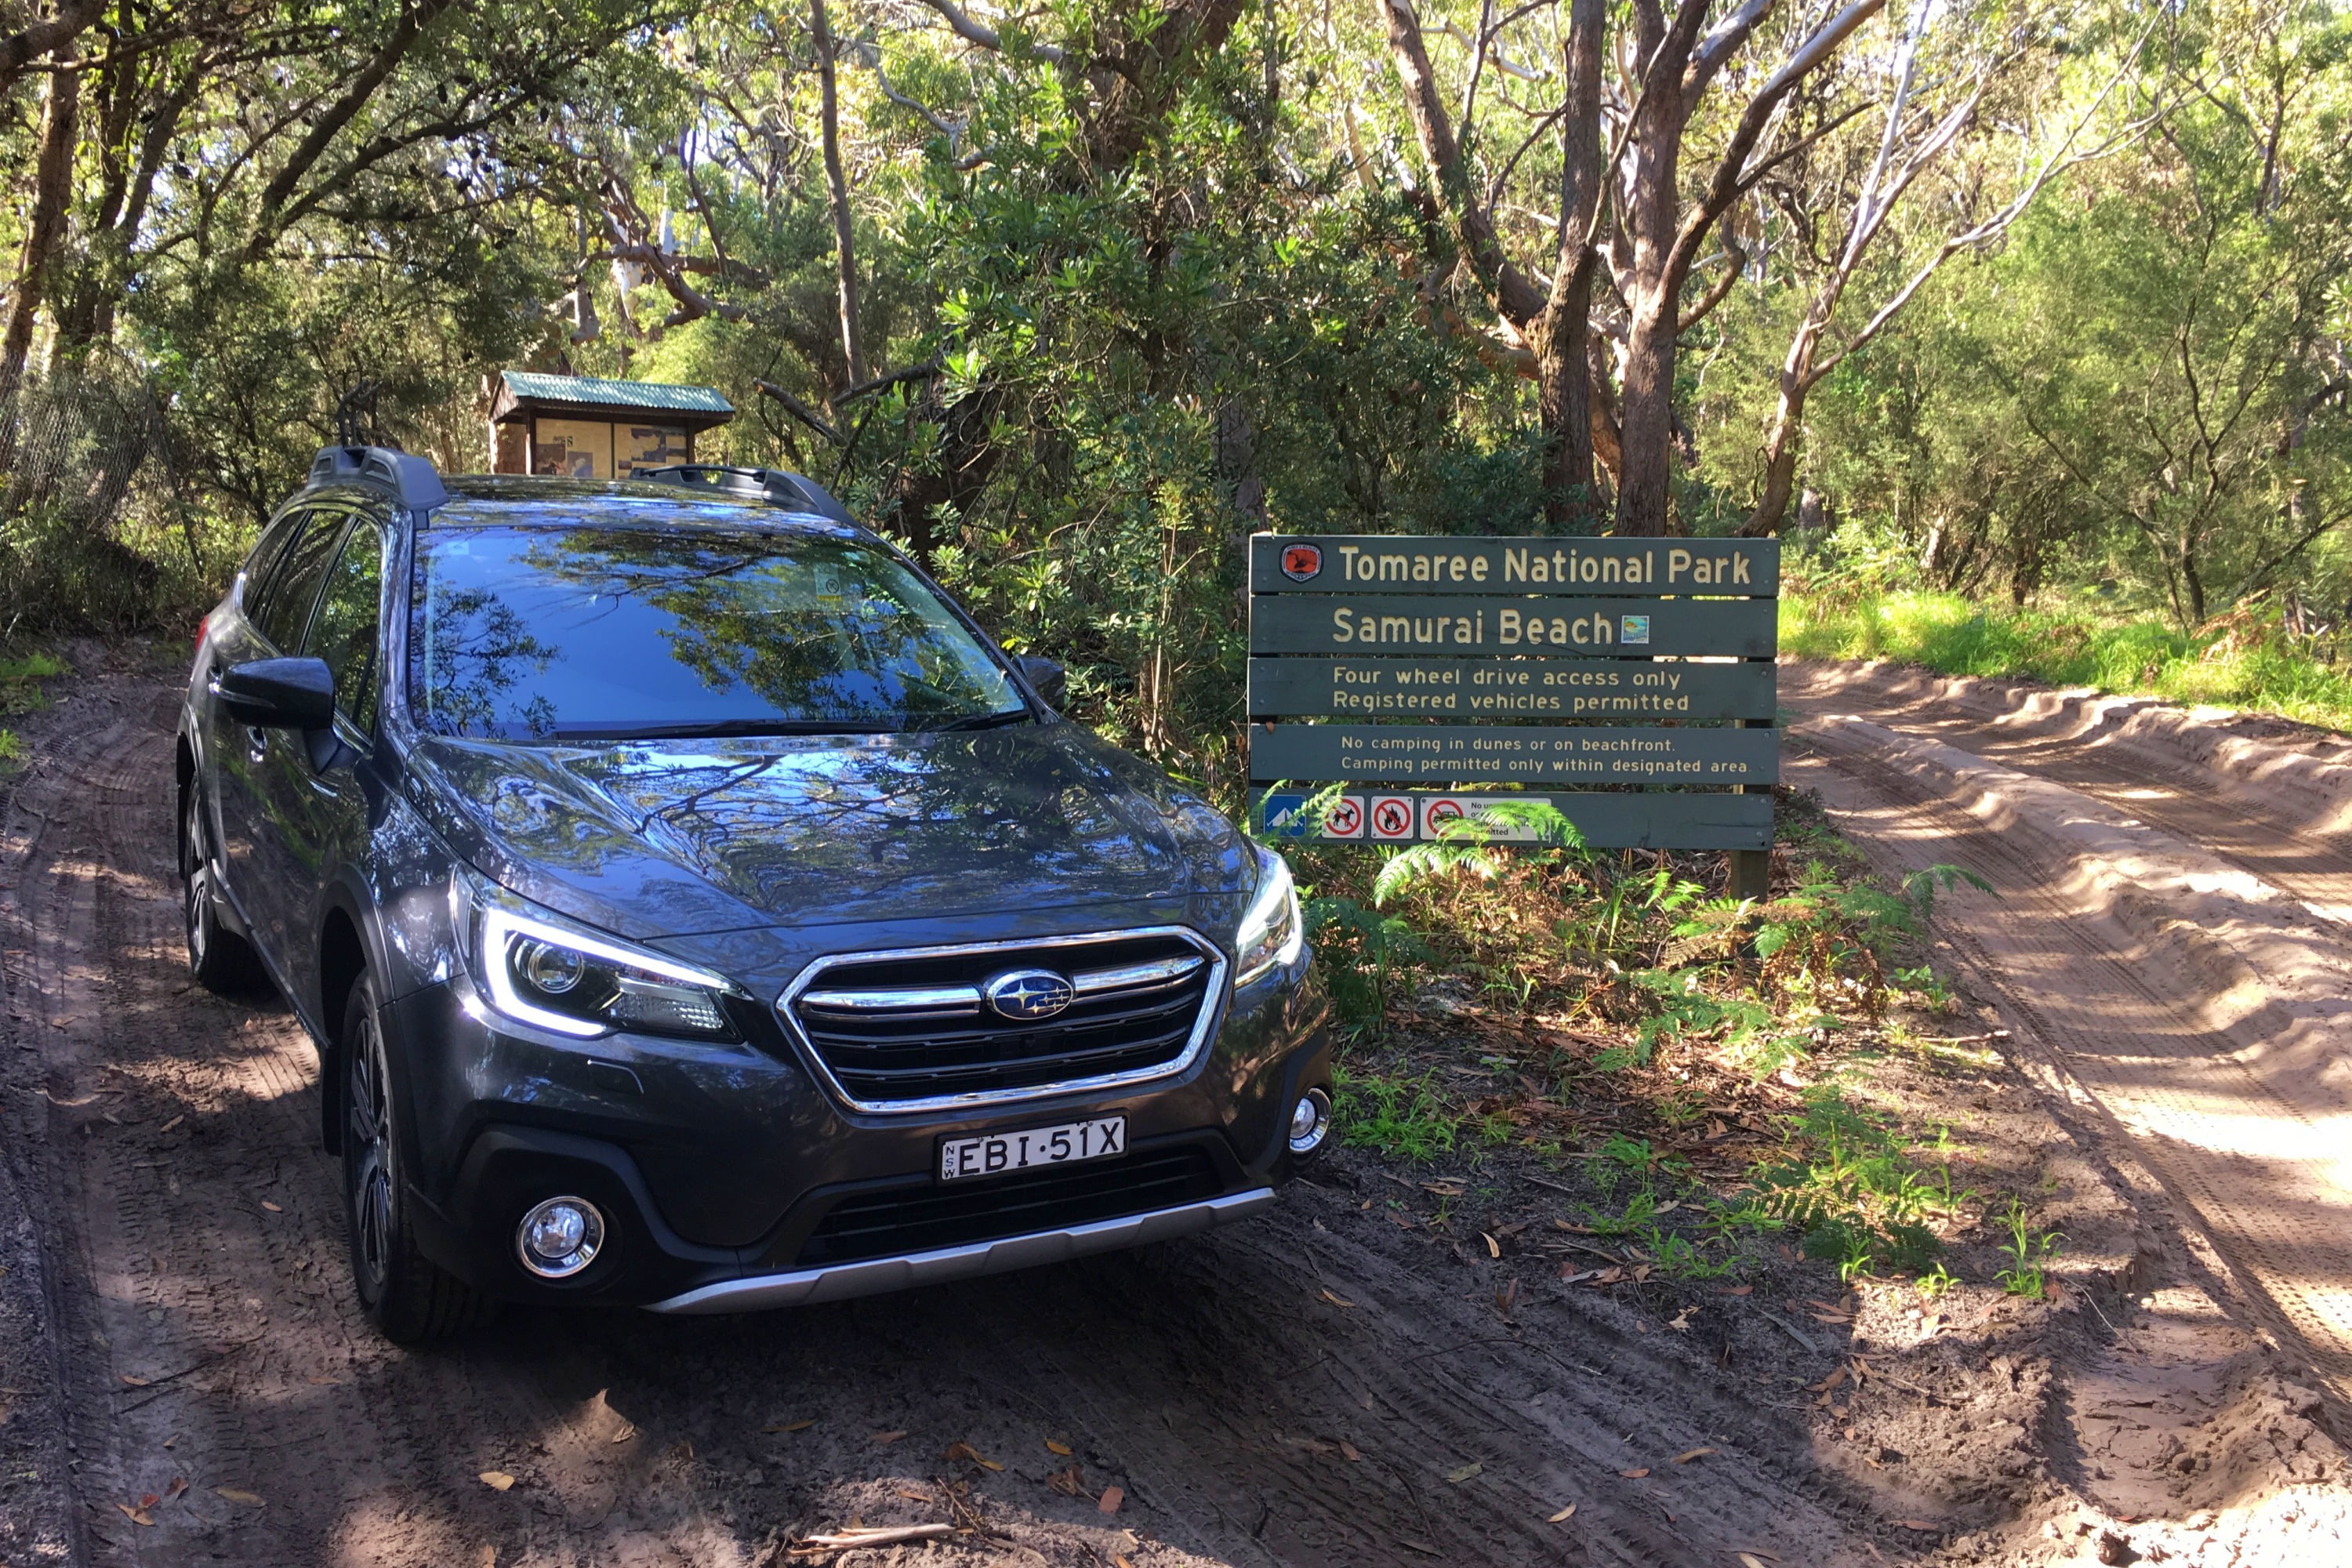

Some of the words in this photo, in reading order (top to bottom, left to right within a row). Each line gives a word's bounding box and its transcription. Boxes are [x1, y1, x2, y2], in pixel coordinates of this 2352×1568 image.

[1339, 546, 1489, 582] Tomaree
[1504, 548, 1653, 583] National
[1668, 549, 1750, 584] Park
[1334, 607, 1483, 644] Samurai
[1500, 609, 1612, 644] Beach
[1334, 666, 1381, 684] Four
[1396, 667, 1460, 684] wheel
[1473, 668, 1530, 685] drive
[1543, 672, 1620, 686] access
[1632, 670, 1681, 690] only
[1334, 691, 1456, 713] Registered
[1470, 693, 1560, 710] vehicles
[1573, 694, 1689, 713] permitted
[1341, 736, 1363, 750] No
[1371, 738, 1440, 753] camping
[1450, 738, 1464, 750] in
[1473, 737, 1522, 750] dunes
[1530, 740, 1546, 751] or
[1554, 740, 1573, 751] on
[1341, 757, 1413, 773] Camping
[1421, 758, 1500, 773] permitted
[1508, 758, 1544, 775] only
[1552, 758, 1603, 772] within
[1612, 759, 1701, 775] designated
